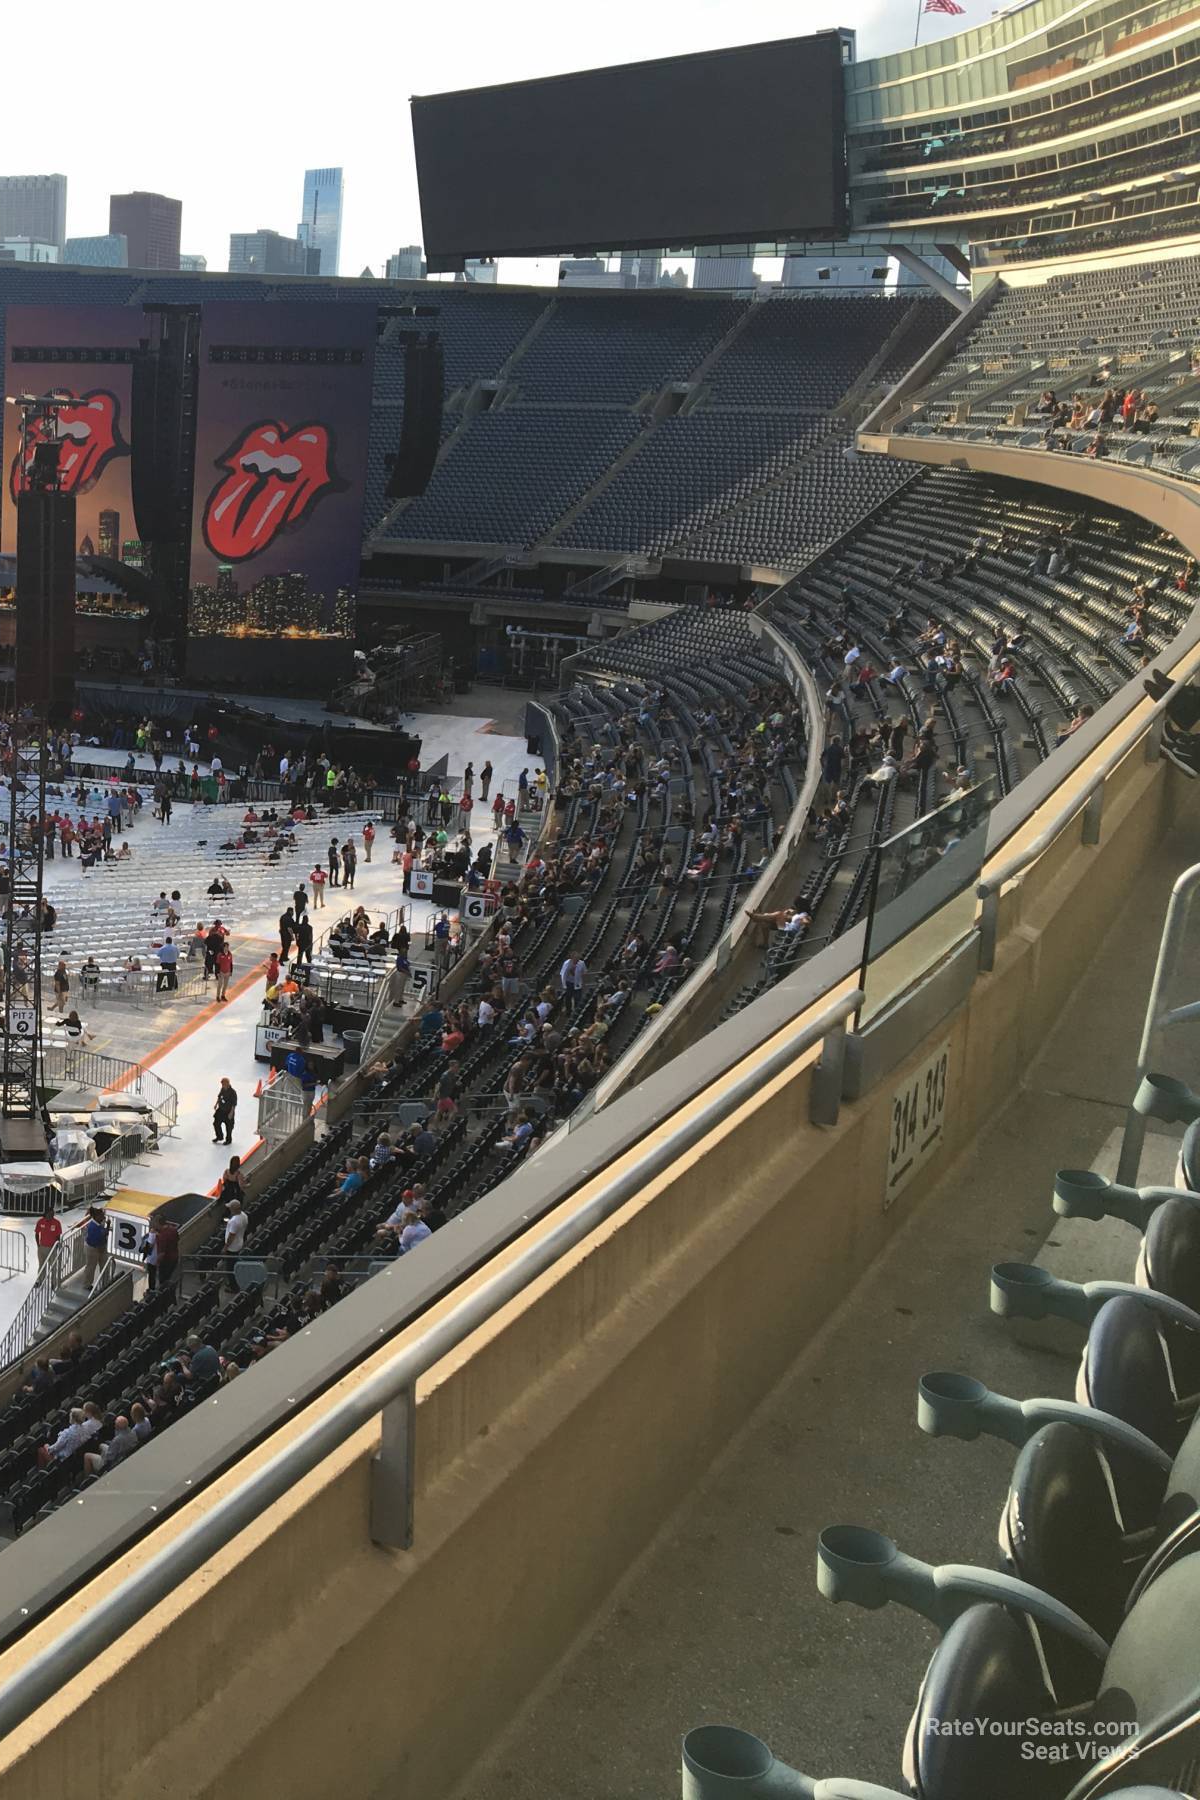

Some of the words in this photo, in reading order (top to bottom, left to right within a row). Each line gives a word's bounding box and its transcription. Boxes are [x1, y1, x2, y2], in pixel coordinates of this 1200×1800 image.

[468, 901, 482, 917] 6
[160, 975, 169, 989] A
[413, 970, 428, 989] 5
[12, 1011, 26, 1020] PIT
[28, 1011, 34, 1020] 2
[264, 1030, 280, 1040] Lite
[890, 1082, 919, 1165] 314
[922, 1053, 947, 1130] 313
[118, 1222, 137, 1250] 3
